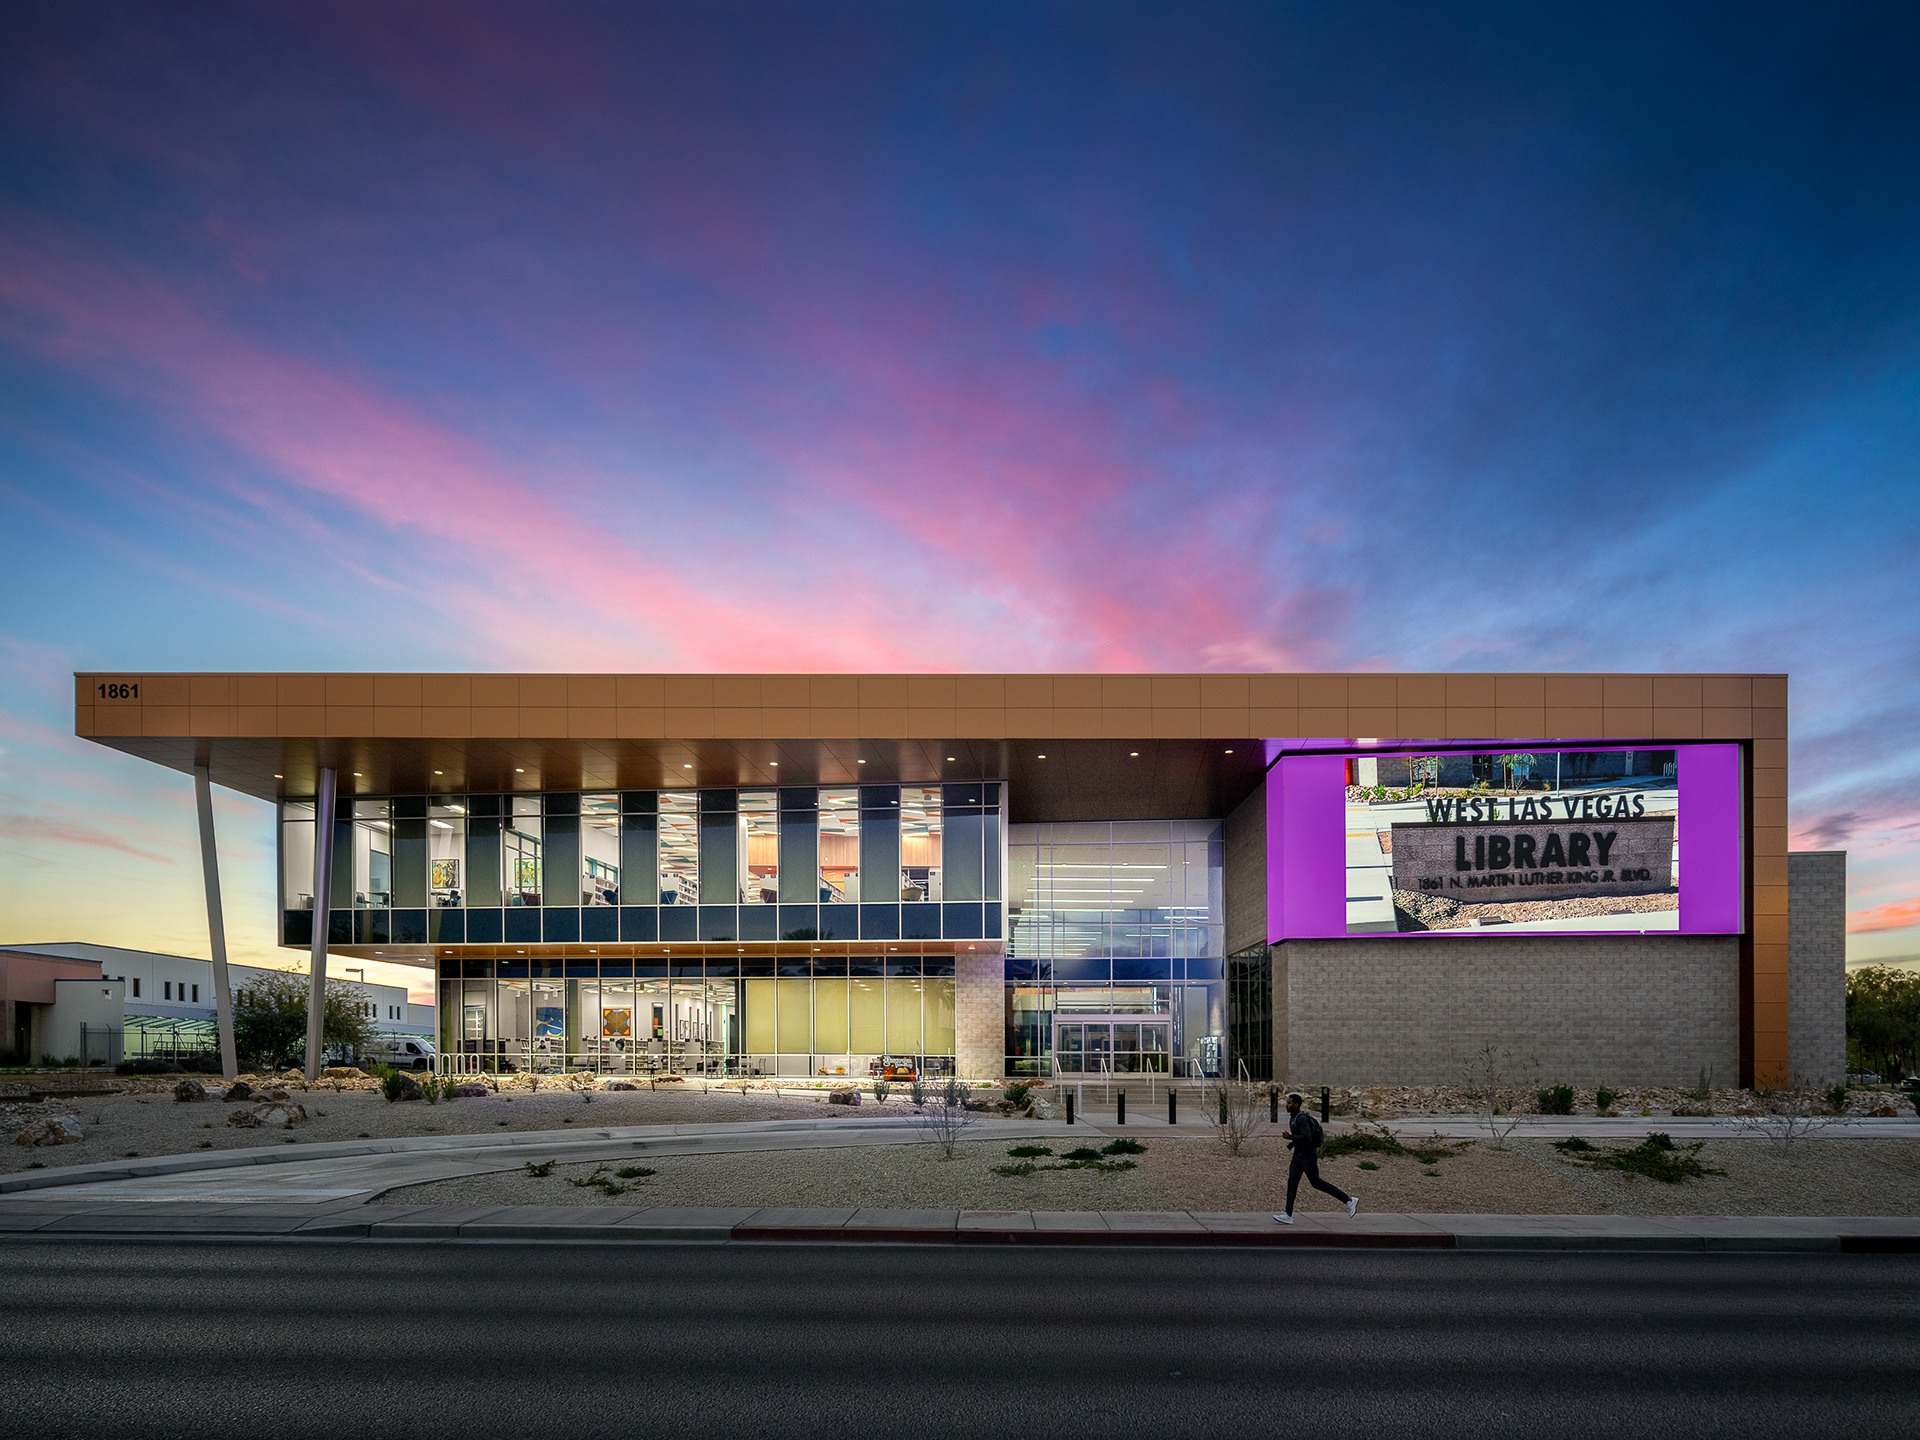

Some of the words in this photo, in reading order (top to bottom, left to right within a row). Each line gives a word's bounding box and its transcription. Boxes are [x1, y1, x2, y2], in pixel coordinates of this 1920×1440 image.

[98, 684, 138, 699] 1861
[1426, 797, 1498, 822] WEST
[1509, 796, 1552, 821] LAS
[1562, 794, 1645, 819] VEGAS
[1456, 831, 1618, 871] LIBRARY
[1418, 877, 1444, 891] 1861
[1450, 877, 1463, 889] N.
[1467, 873, 1515, 888] MARTIN
[1519, 871, 1564, 886] LUTHER
[1566, 870, 1599, 884] KING
